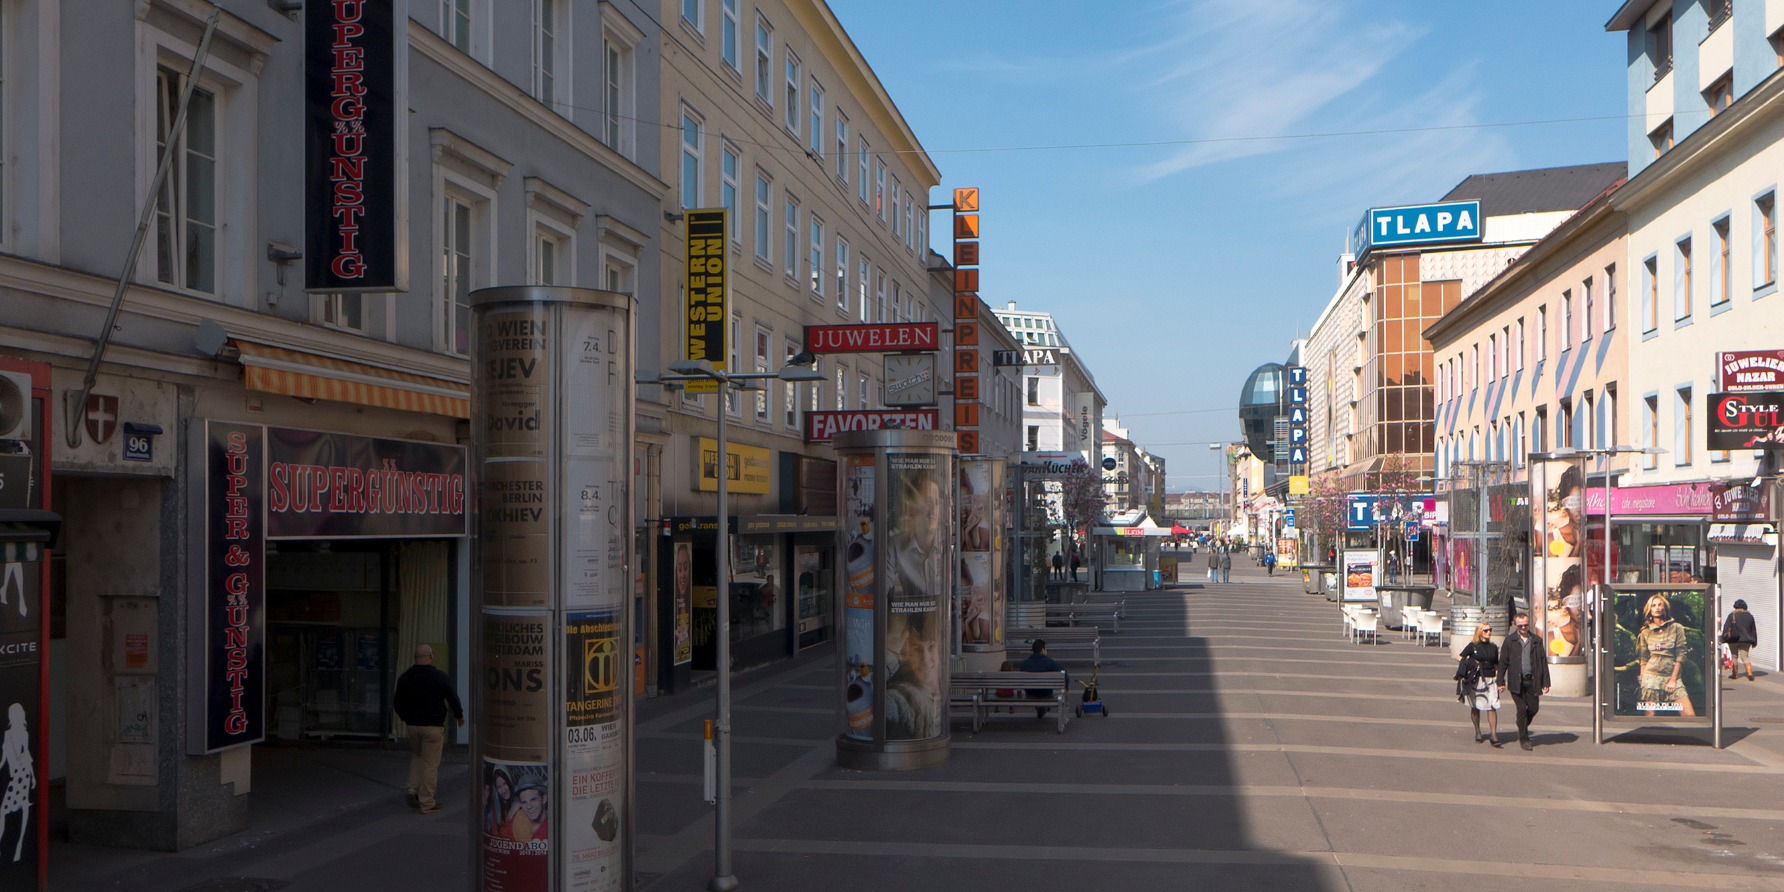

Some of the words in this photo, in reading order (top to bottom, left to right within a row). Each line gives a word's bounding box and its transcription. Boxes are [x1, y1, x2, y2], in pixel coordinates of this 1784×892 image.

[1376, 210, 1474, 236] TLAPA
[706, 238, 723, 322] UNION
[689, 238, 706, 360] WESTERN
[496, 320, 547, 337] WIEN
[959, 190, 975, 452] KLEINPREIS
[814, 327, 932, 348] JUWELEN
[583, 341, 602, 353] 7.4.
[998, 350, 1056, 365] TLAPA
[1724, 357, 1784, 375] JUWELIER
[888, 374, 922, 393] swatch
[1736, 372, 1776, 383] NAZAR
[1292, 368, 1304, 462] TLAPA
[1725, 400, 1779, 418] STYLE
[487, 410, 541, 431] David
[1081, 405, 1090, 441] Vögele
[129, 437, 149, 453] 96
[225, 431, 250, 540] SUPER
[270, 458, 464, 515] SUPERGÜNSTIG
[502, 493, 543, 504] BERLIN
[581, 490, 602, 501] 8.4.
[1723, 486, 1759, 505] JUWELIER
[1732, 502, 1750, 512] NAZAR
[225, 544, 250, 567] &
[225, 572, 250, 735] GÜNSTIG
[566, 698, 613, 712] TANGERINE
[569, 711, 595, 721] Phaedra
[568, 727, 597, 744] 03.06.
[601, 722, 617, 732] WIEN
[573, 774, 588, 785] EIN
[590, 769, 615, 783] KOFFER
[572, 785, 588, 796] DIE
[589, 779, 614, 794] LETZTE
[490, 839, 547, 851] JUGENDABO
